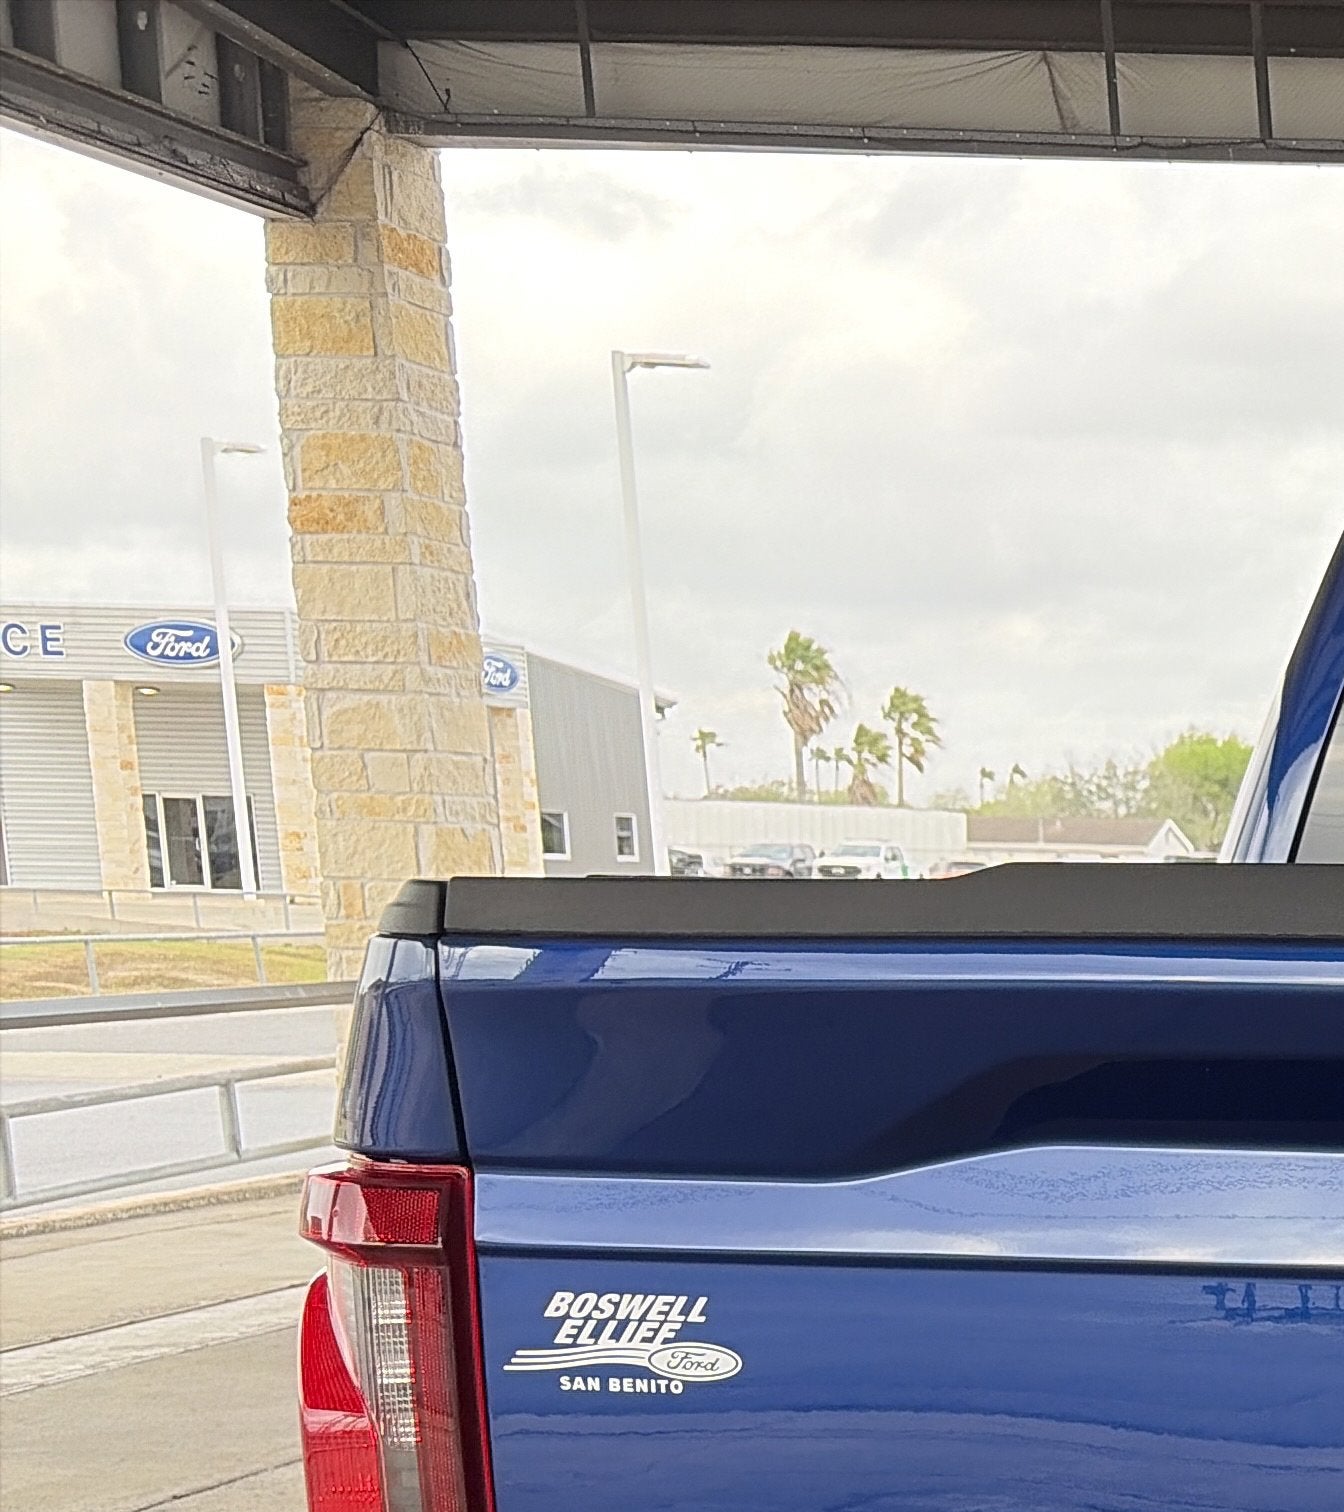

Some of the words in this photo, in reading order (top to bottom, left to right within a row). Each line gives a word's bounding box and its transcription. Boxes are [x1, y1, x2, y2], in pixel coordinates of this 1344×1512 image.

[146, 628, 211, 658] Ford
[482, 658, 512, 687] Ford
[543, 1291, 709, 1323] BOSWELL
[553, 1319, 682, 1345] ELLIFF
[667, 1350, 720, 1372] Ford
[559, 1375, 601, 1392] SAN
[608, 1377, 684, 1395] BENITO
